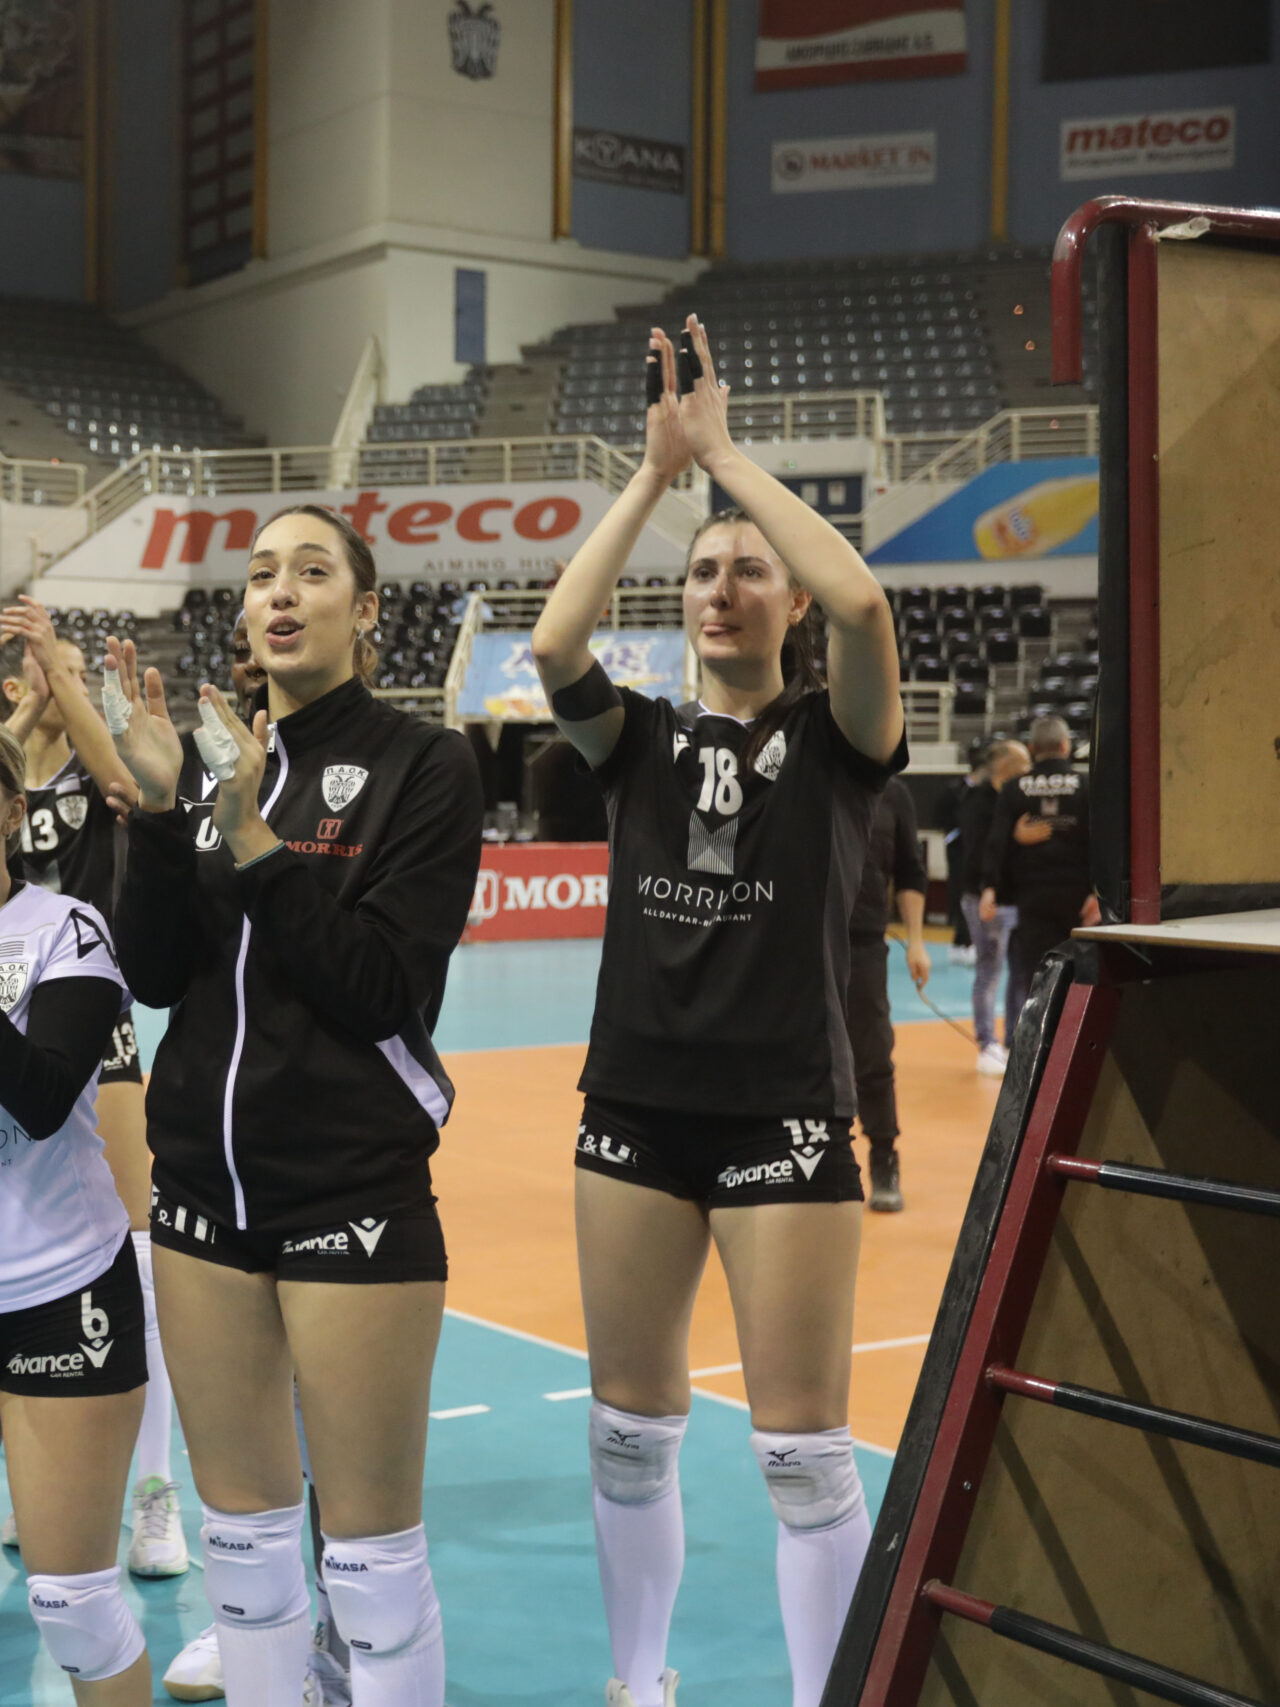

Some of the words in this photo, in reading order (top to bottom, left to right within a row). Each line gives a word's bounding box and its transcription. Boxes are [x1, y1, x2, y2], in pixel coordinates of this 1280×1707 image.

[1065, 114, 1232, 154] mateco
[809, 146, 899, 171] MARKET
[141, 492, 581, 568] mteco
[696, 747, 743, 815] 18
[285, 841, 364, 868] MORRIS
[112, 1022, 137, 1055] 13
[81, 1291, 109, 1339] 6
